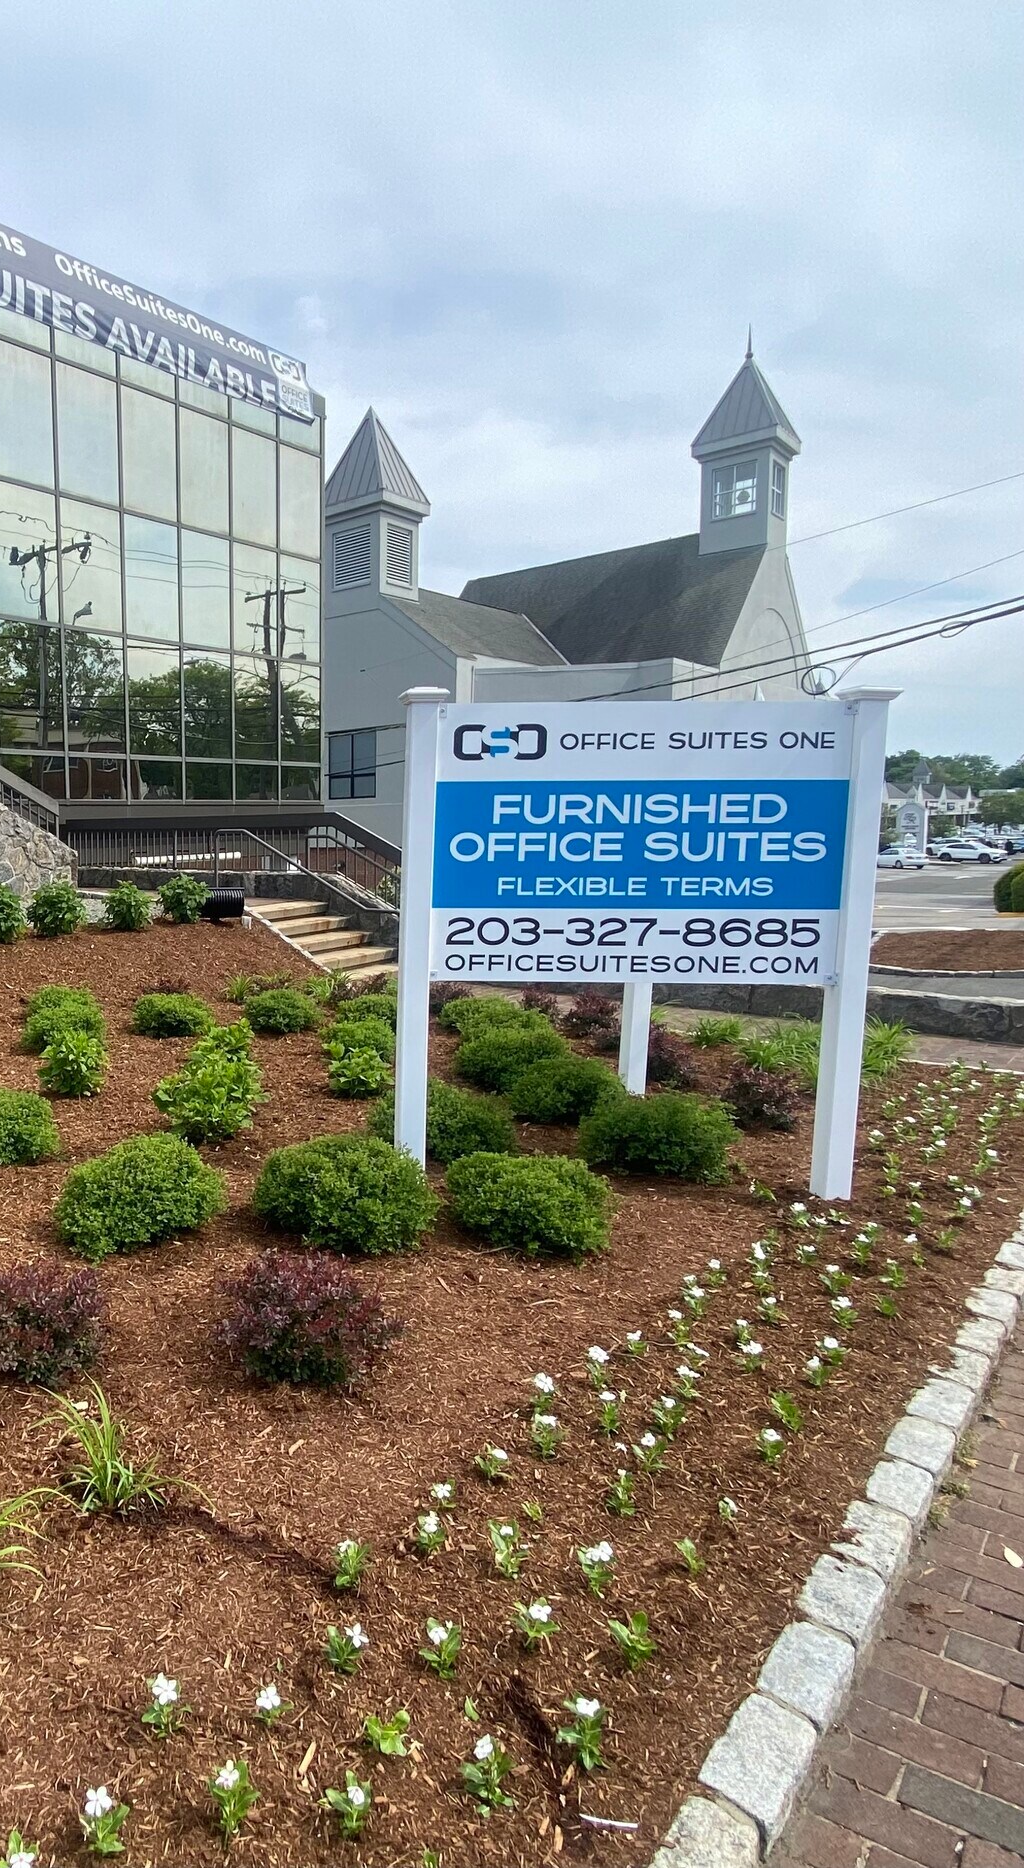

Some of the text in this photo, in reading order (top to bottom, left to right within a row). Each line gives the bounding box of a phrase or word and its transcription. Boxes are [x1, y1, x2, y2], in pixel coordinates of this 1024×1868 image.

[54, 253, 267, 364] OfficeSuitesOne.com
[106, 317, 277, 411] AVAILABLE
[281, 384, 308, 403] OFFICE
[559, 731, 836, 751] OFFICE SUITES ONE
[492, 793, 788, 825] FURNISHED
[449, 831, 827, 863] OFFICE SUITES
[497, 877, 774, 897] FLEXIBLE TERMS
[445, 917, 821, 947] 203-327-8685
[444, 954, 819, 975] OFFICESUITESONE.COM
